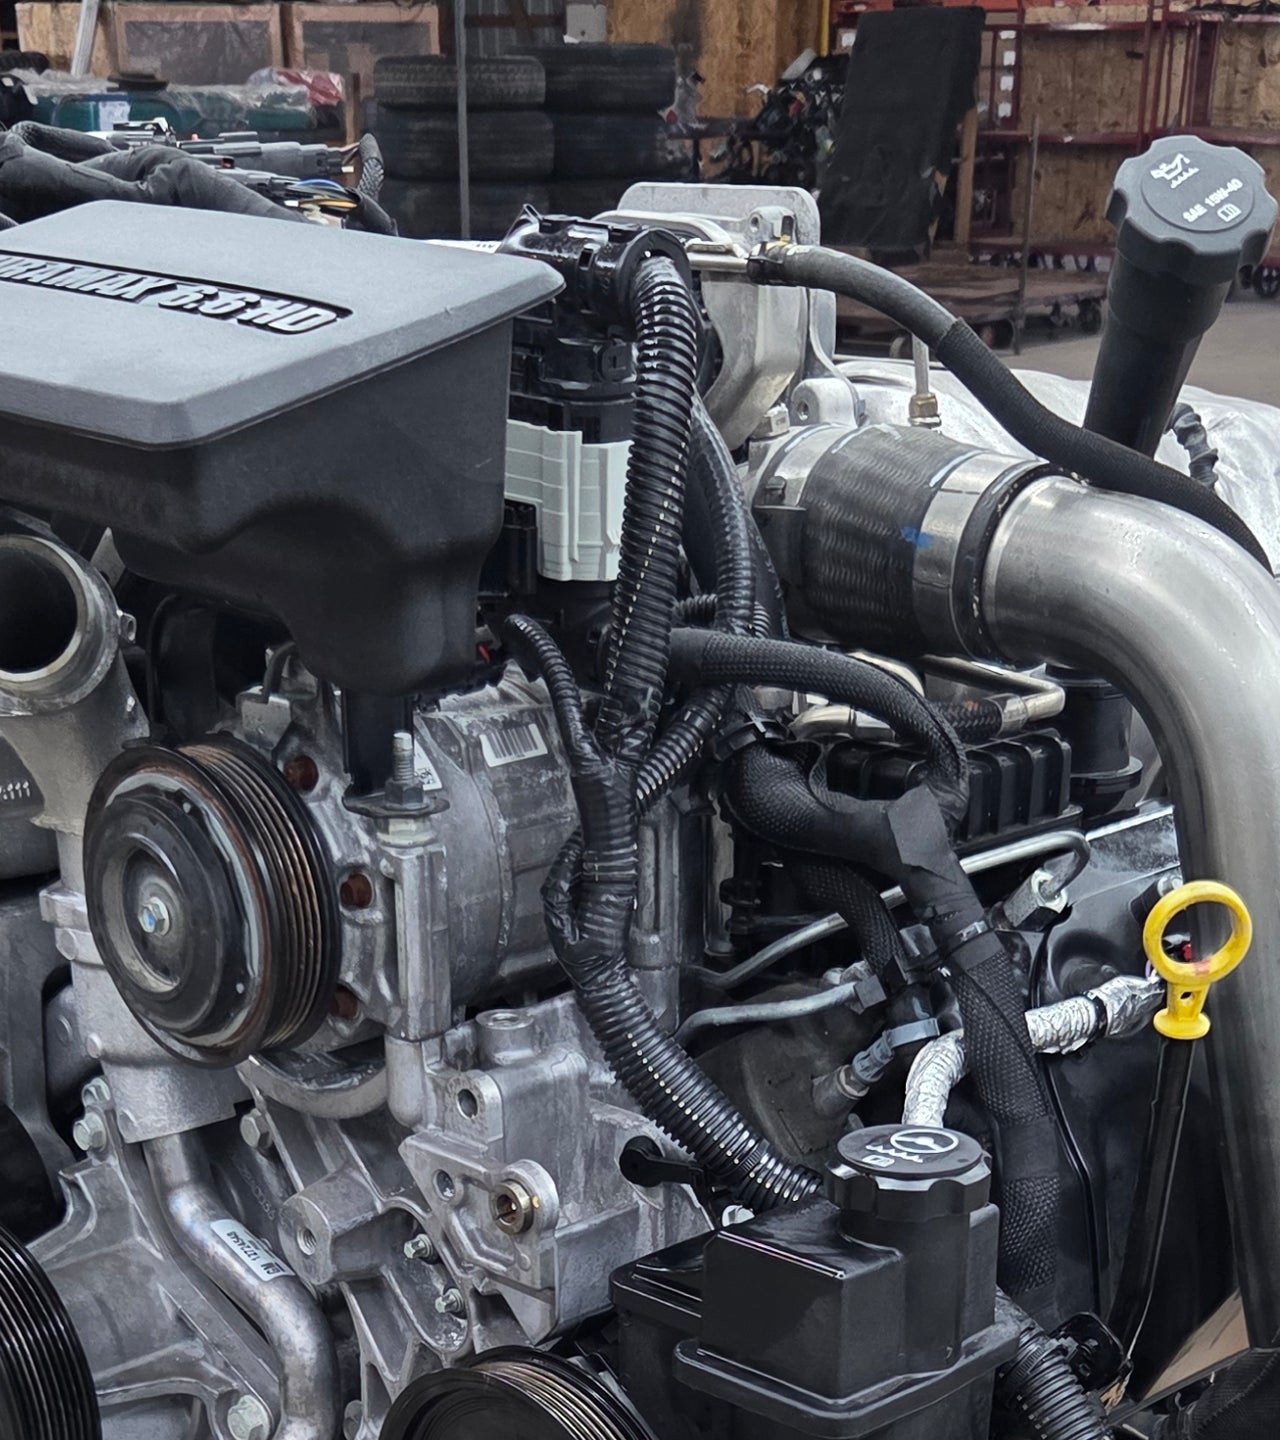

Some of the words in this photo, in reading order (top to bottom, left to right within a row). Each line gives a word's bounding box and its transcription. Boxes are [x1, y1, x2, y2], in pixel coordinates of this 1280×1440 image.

[1183, 203, 1208, 222] SAE
[1205, 178, 1243, 207] 15W-40
[160, 283, 261, 318] 6.6
[238, 298, 341, 335] HD
